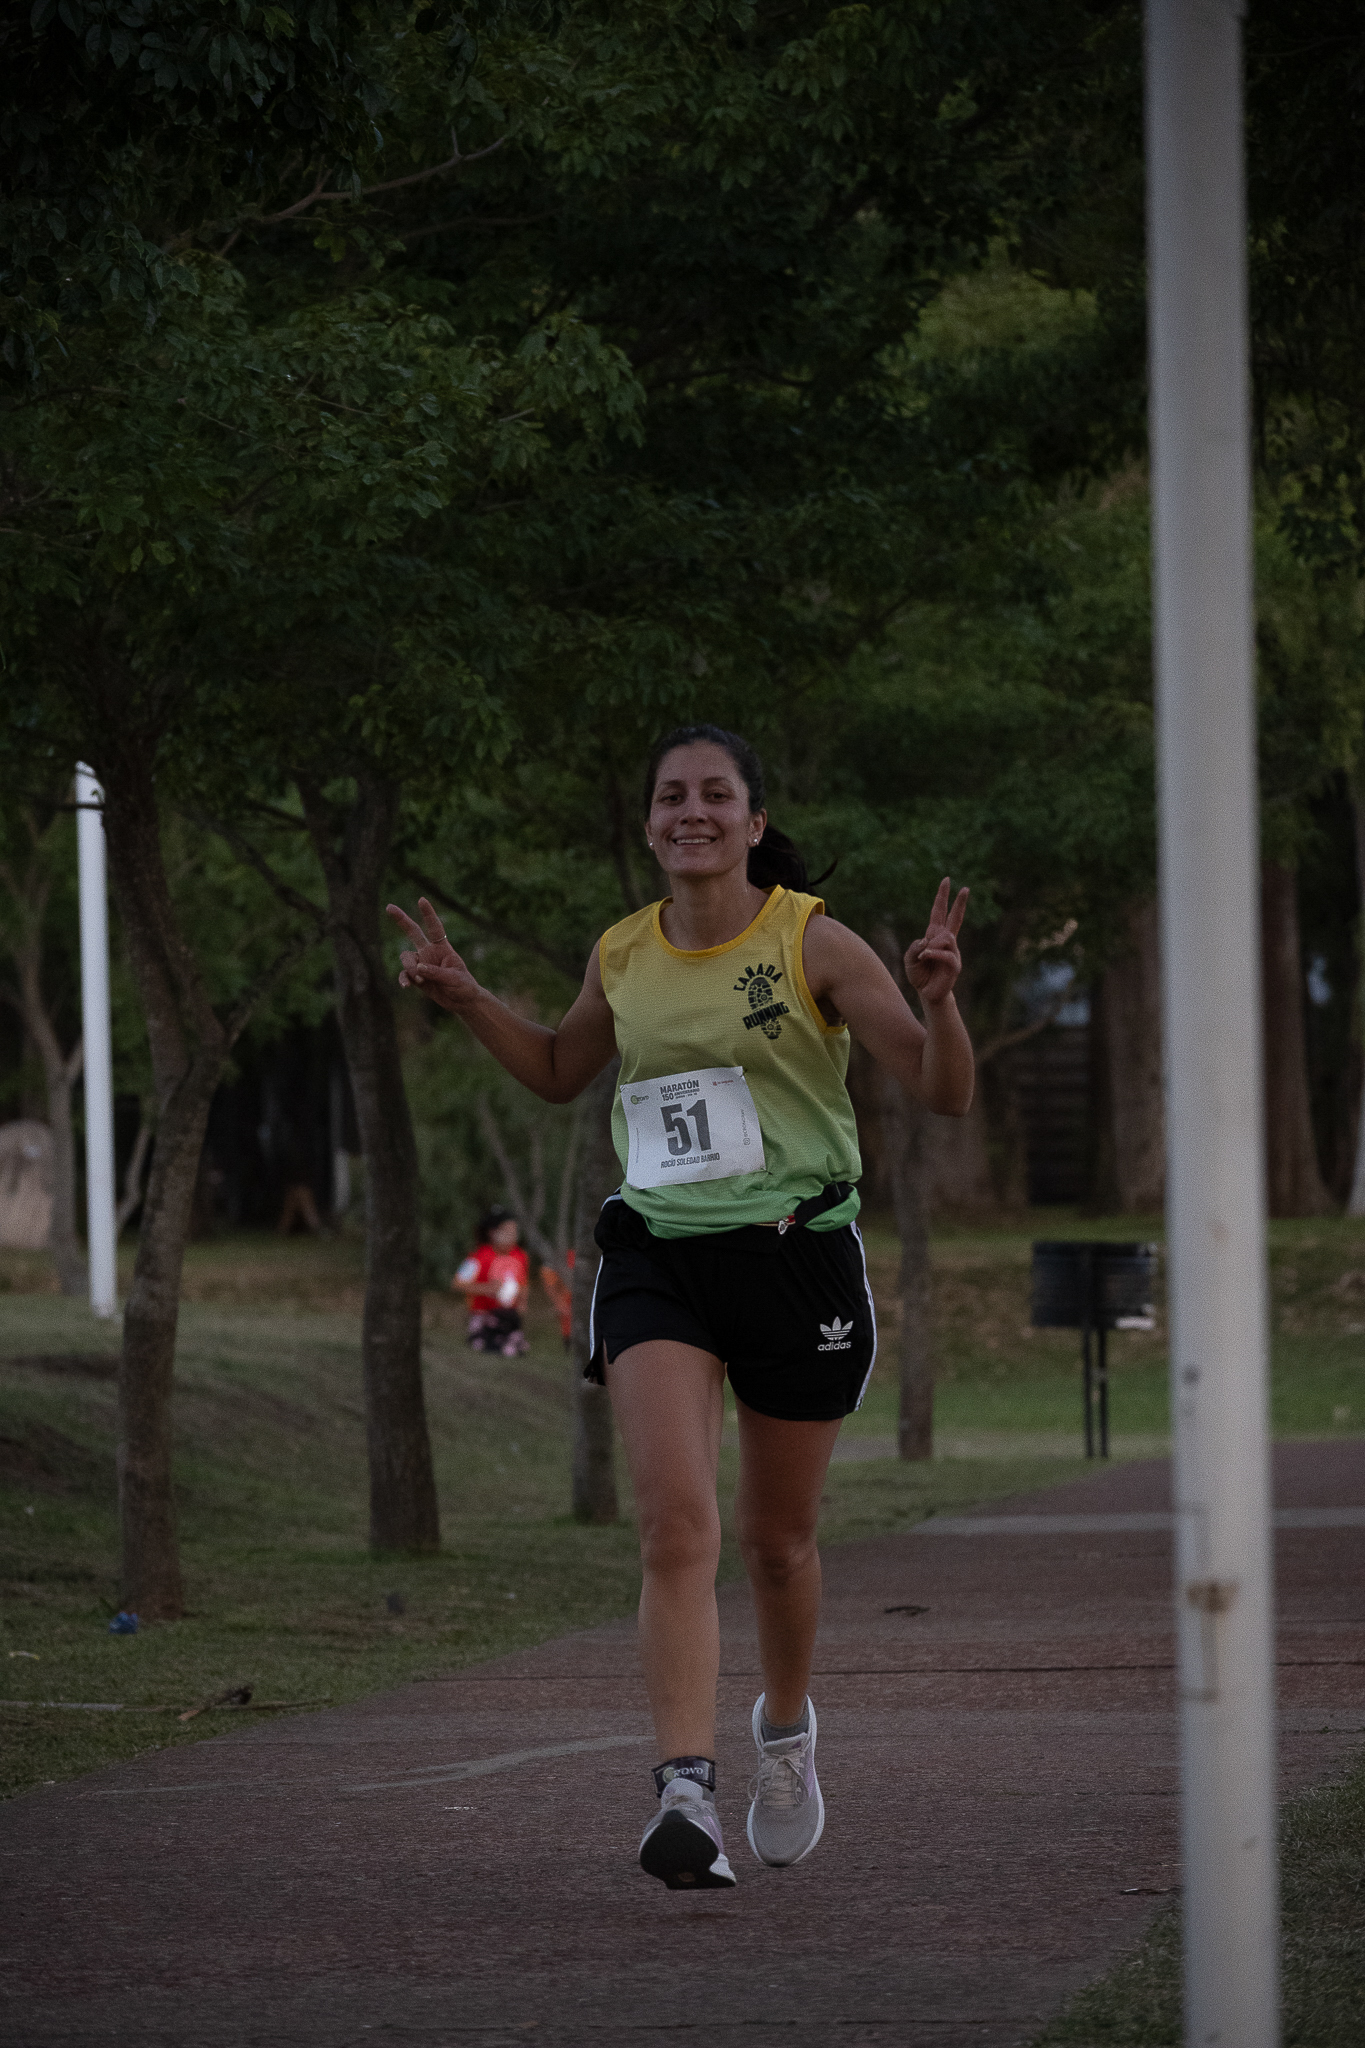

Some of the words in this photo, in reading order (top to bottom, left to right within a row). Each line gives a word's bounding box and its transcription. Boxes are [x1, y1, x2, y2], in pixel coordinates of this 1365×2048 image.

[733, 963, 783, 991] CAÑADA
[742, 1001, 790, 1030] RUNNING
[660, 1079, 700, 1095] MARATÓN
[662, 1093, 674, 1101] 150
[660, 1099, 712, 1156] 51
[676, 1156, 700, 1166] SOLEDAD
[817, 1341, 852, 1351] adidas
